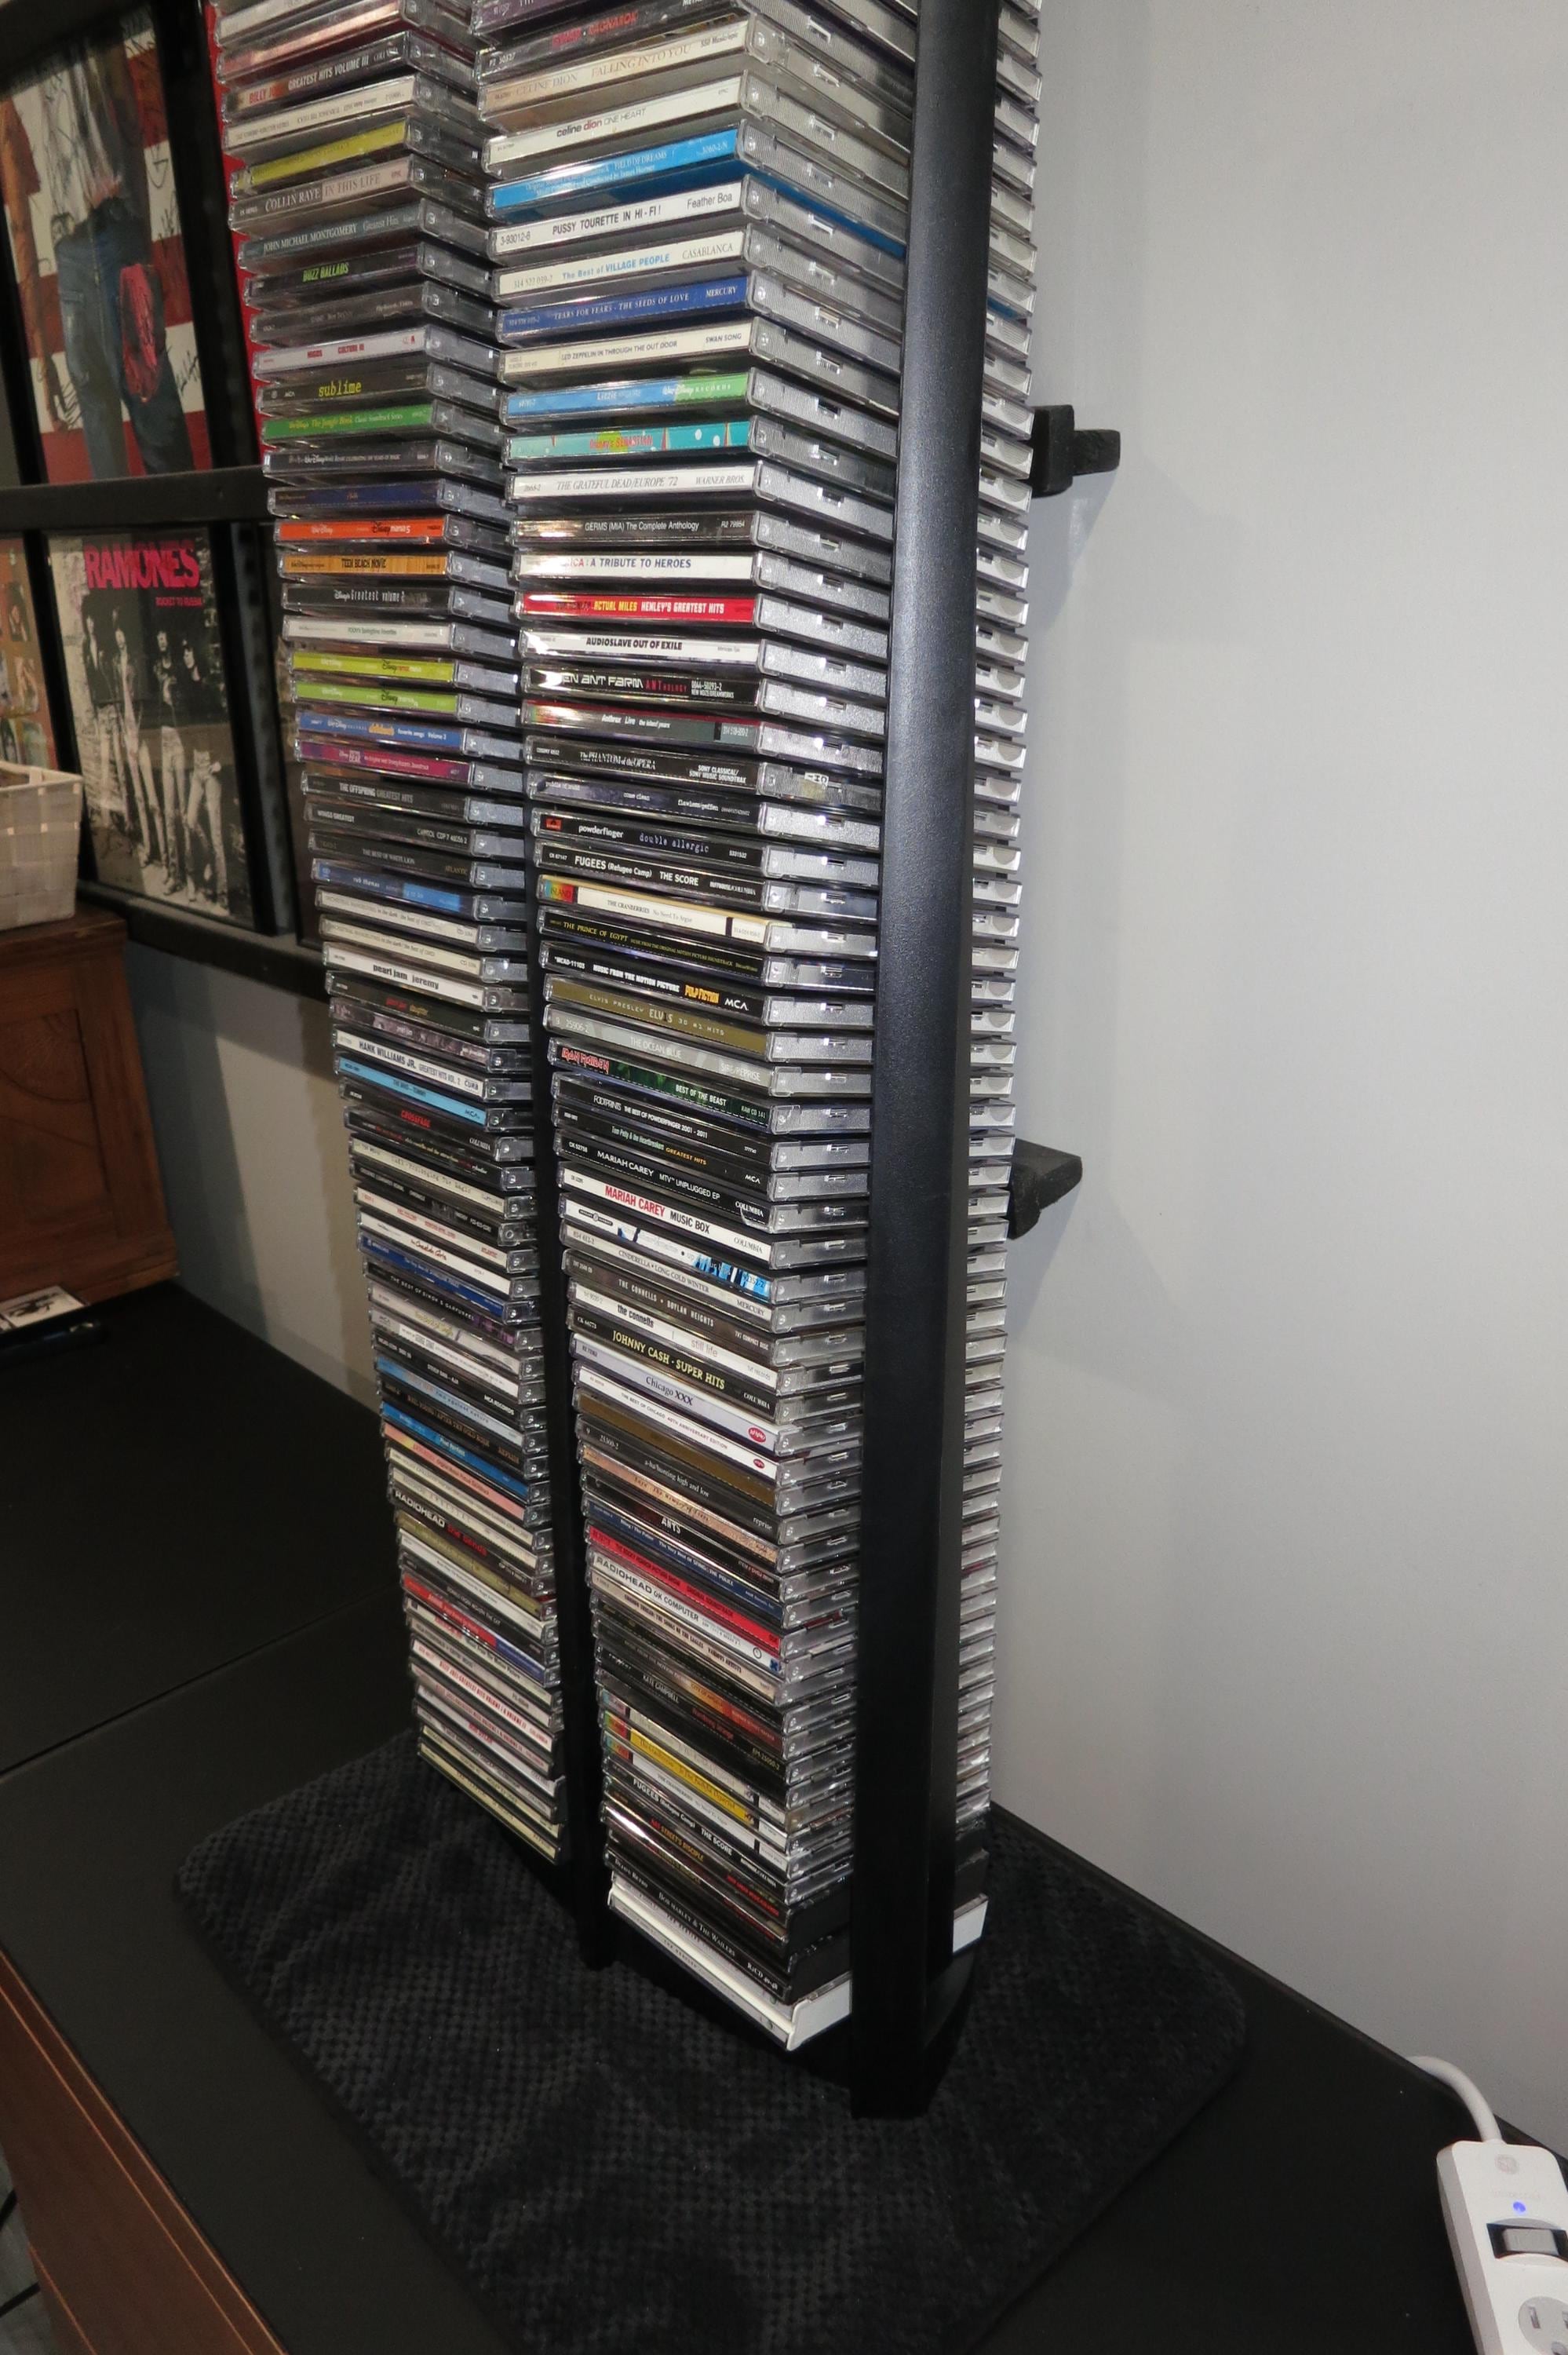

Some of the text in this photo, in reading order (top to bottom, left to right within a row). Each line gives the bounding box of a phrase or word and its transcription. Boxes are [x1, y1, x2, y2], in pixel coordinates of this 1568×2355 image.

[288, 74, 316, 89] GREATEST
[319, 68, 332, 80] HITS
[334, 60, 359, 75] VOLUME
[516, 58, 636, 96] CELINE DION FALLING
[556, 108, 646, 137] celine dion HEART
[265, 173, 381, 212] COLLIN RAYE IN THIS LIFE
[552, 192, 732, 236] PUSSY TOURETTE IN Feather Boa
[264, 223, 357, 252] JOHN MICHAEL MONTGOMERY
[303, 262, 349, 282] BUZZ BALLADS
[578, 268, 594, 278] Best
[605, 259, 636, 272] VILLAGE
[639, 254, 669, 265] PEOPLE
[682, 243, 734, 260] CASABLANCA
[554, 286, 737, 320] TEARS FOR FEARS THE SEEDS OF LOVE MERCURY
[572, 333, 742, 360] ZEPPELIN THROUGH THE OUT DOOR SWAN SONG
[319, 380, 362, 397] sublime
[557, 475, 724, 491] THE GRATEFUL DEAD/EUROPE WARNER
[585, 520, 699, 532] GERMS (MIA) The Complete Anthology
[83, 541, 200, 590] RAMONES
[355, 559, 370, 568] BEACH
[371, 558, 386, 568] MOVIE
[600, 559, 636, 568] TRIBUTE
[640, 559, 651, 568] TO
[655, 559, 691, 568] HEROES
[594, 601, 724, 614] ACTUAL MILES HENLEY'S GREATEST HITS
[586, 637, 682, 650] AUDIOSLAVE OUT OF EXILE
[602, 714, 636, 725] Anthrax Live
[340, 783, 348, 791] THE
[349, 784, 376, 798] OFFSPRING
[402, 794, 414, 803] HITS
[578, 824, 709, 853] powderfinger double allergic
[574, 856, 698, 885] FUGEES Camp) THE SCORE
[563, 921, 628, 942] THE PRINCE OF EGYPT
[373, 964, 439, 989] pearl jam jeremy
[593, 964, 749, 1011] MUSIC FROM THE MOTION PICTURE MCA
[631, 1037, 681, 1058] THE OCEAN BLUE
[359, 1040, 479, 1090] HANK WILLIAMS JR. CURB
[675, 1084, 727, 1107] BEST OF THE BEAST
[665, 1147, 706, 1166] GREATEST HITS
[597, 1150, 764, 1218] MARIAH CAREY UNPLUGGED EP COLUMBIA
[605, 1185, 763, 1254] MARIAH CAREY MUSIC BOX COLUMBIA
[618, 1249, 765, 1316] CINDERELLA LONG COLD WINTER MERCURY
[618, 1279, 714, 1327] THE CONNELLS BOYLAN HEIGHTS
[618, 1304, 704, 1353] the connells still
[613, 1330, 725, 1390] JOHNNY CASH SUPER HITS
[646, 1376, 694, 1406] Chicago XXX
[395, 1490, 446, 1528] RADIOHEAD
[596, 1556, 698, 1622] RADIOHEAD COMPUTER
[643, 1674, 680, 1703] KATE CAMPBELL
[633, 1779, 732, 1856] FUGEES THE SCORE
